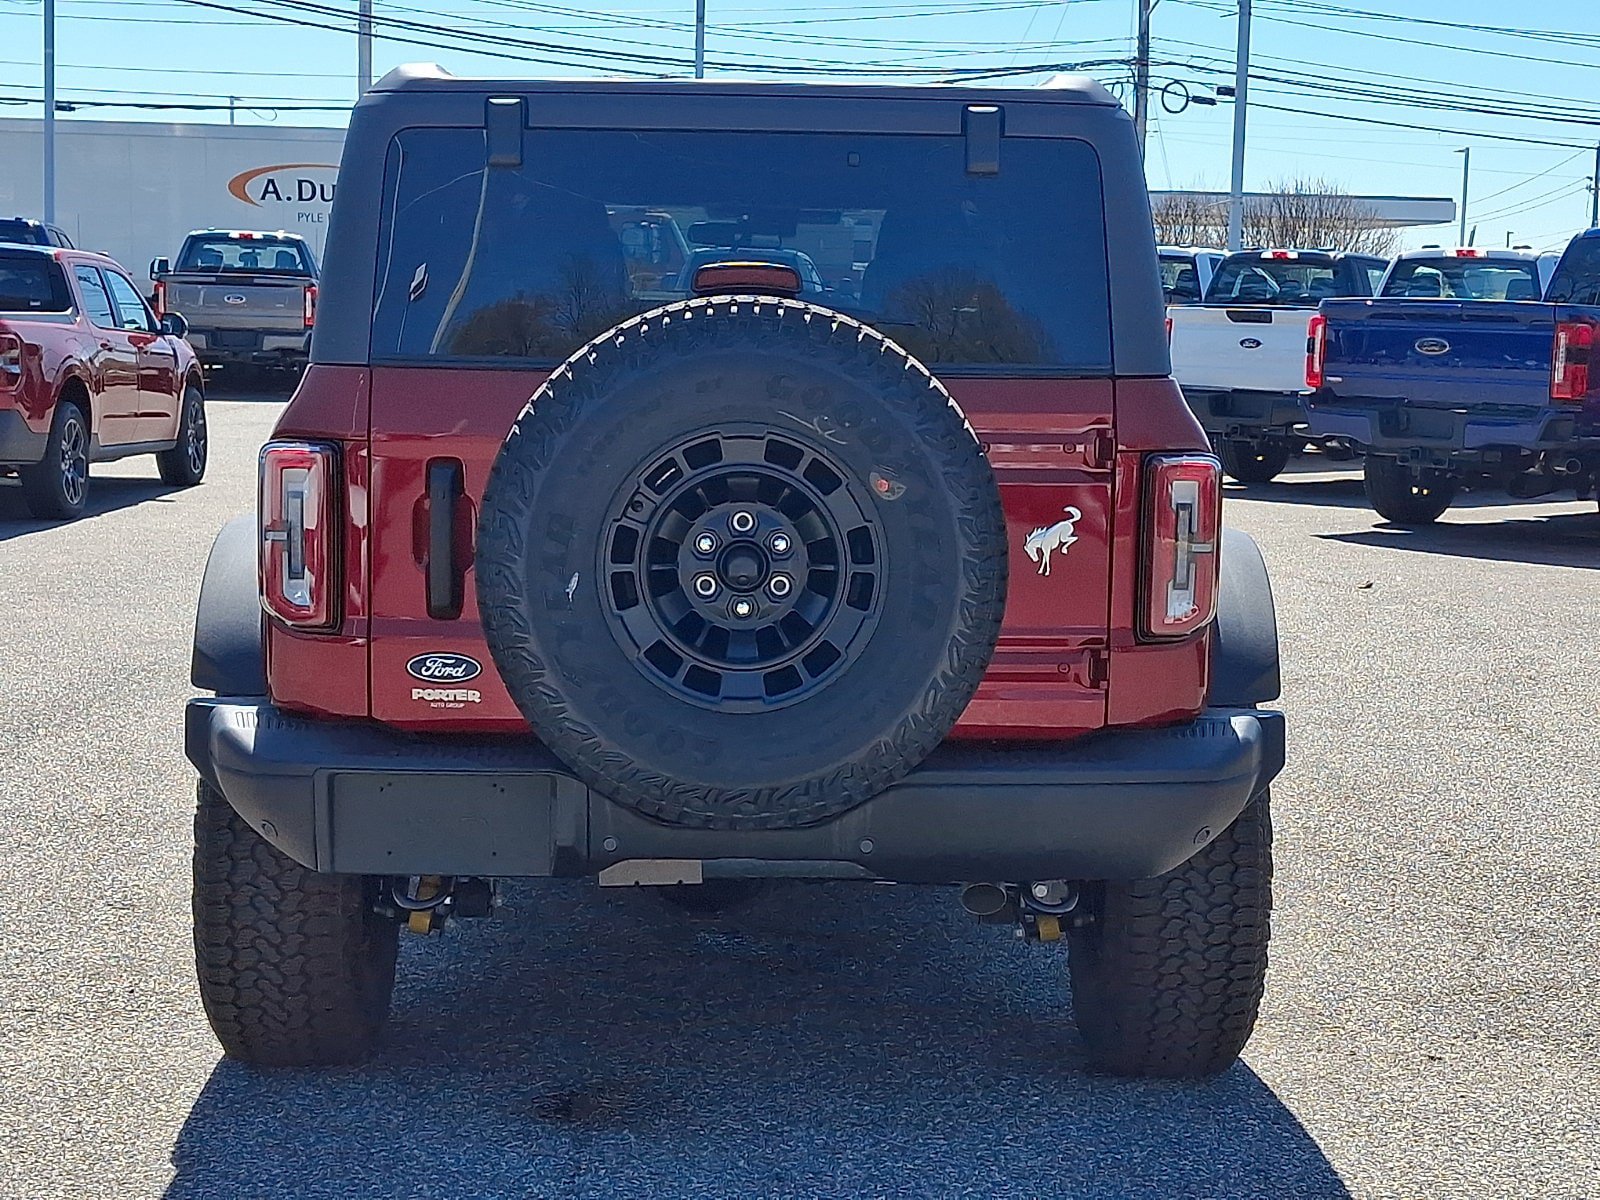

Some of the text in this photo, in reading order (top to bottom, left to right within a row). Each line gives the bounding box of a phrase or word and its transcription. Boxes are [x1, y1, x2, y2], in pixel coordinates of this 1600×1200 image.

[297, 212, 323, 223] PYLE
[421, 657, 467, 677] Ford
[411, 688, 482, 703] PORTER
